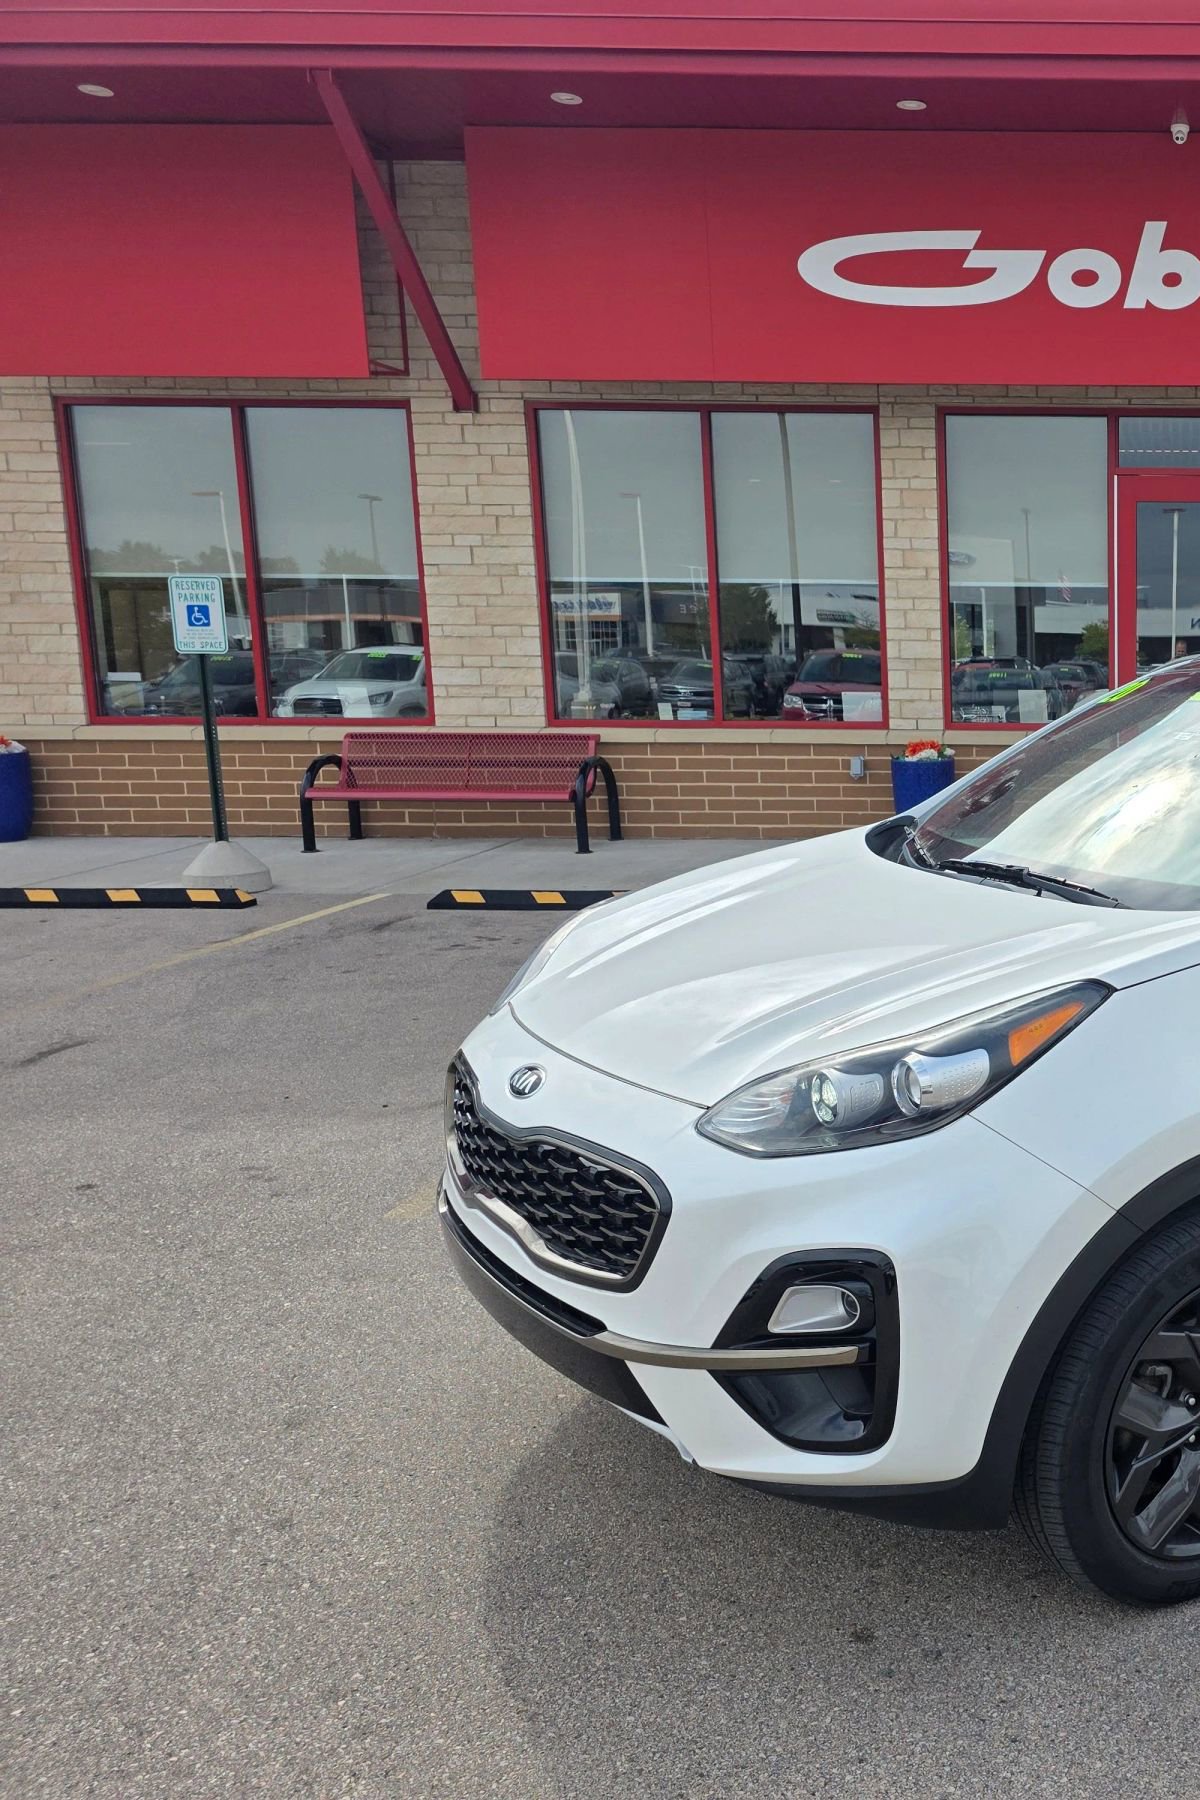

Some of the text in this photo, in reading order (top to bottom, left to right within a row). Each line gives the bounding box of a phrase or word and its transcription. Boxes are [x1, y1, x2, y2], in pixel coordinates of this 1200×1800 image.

[175, 580, 216, 591] RESERVED
[178, 592, 216, 603] PARKING
[179, 641, 224, 649] THIS SPACE
